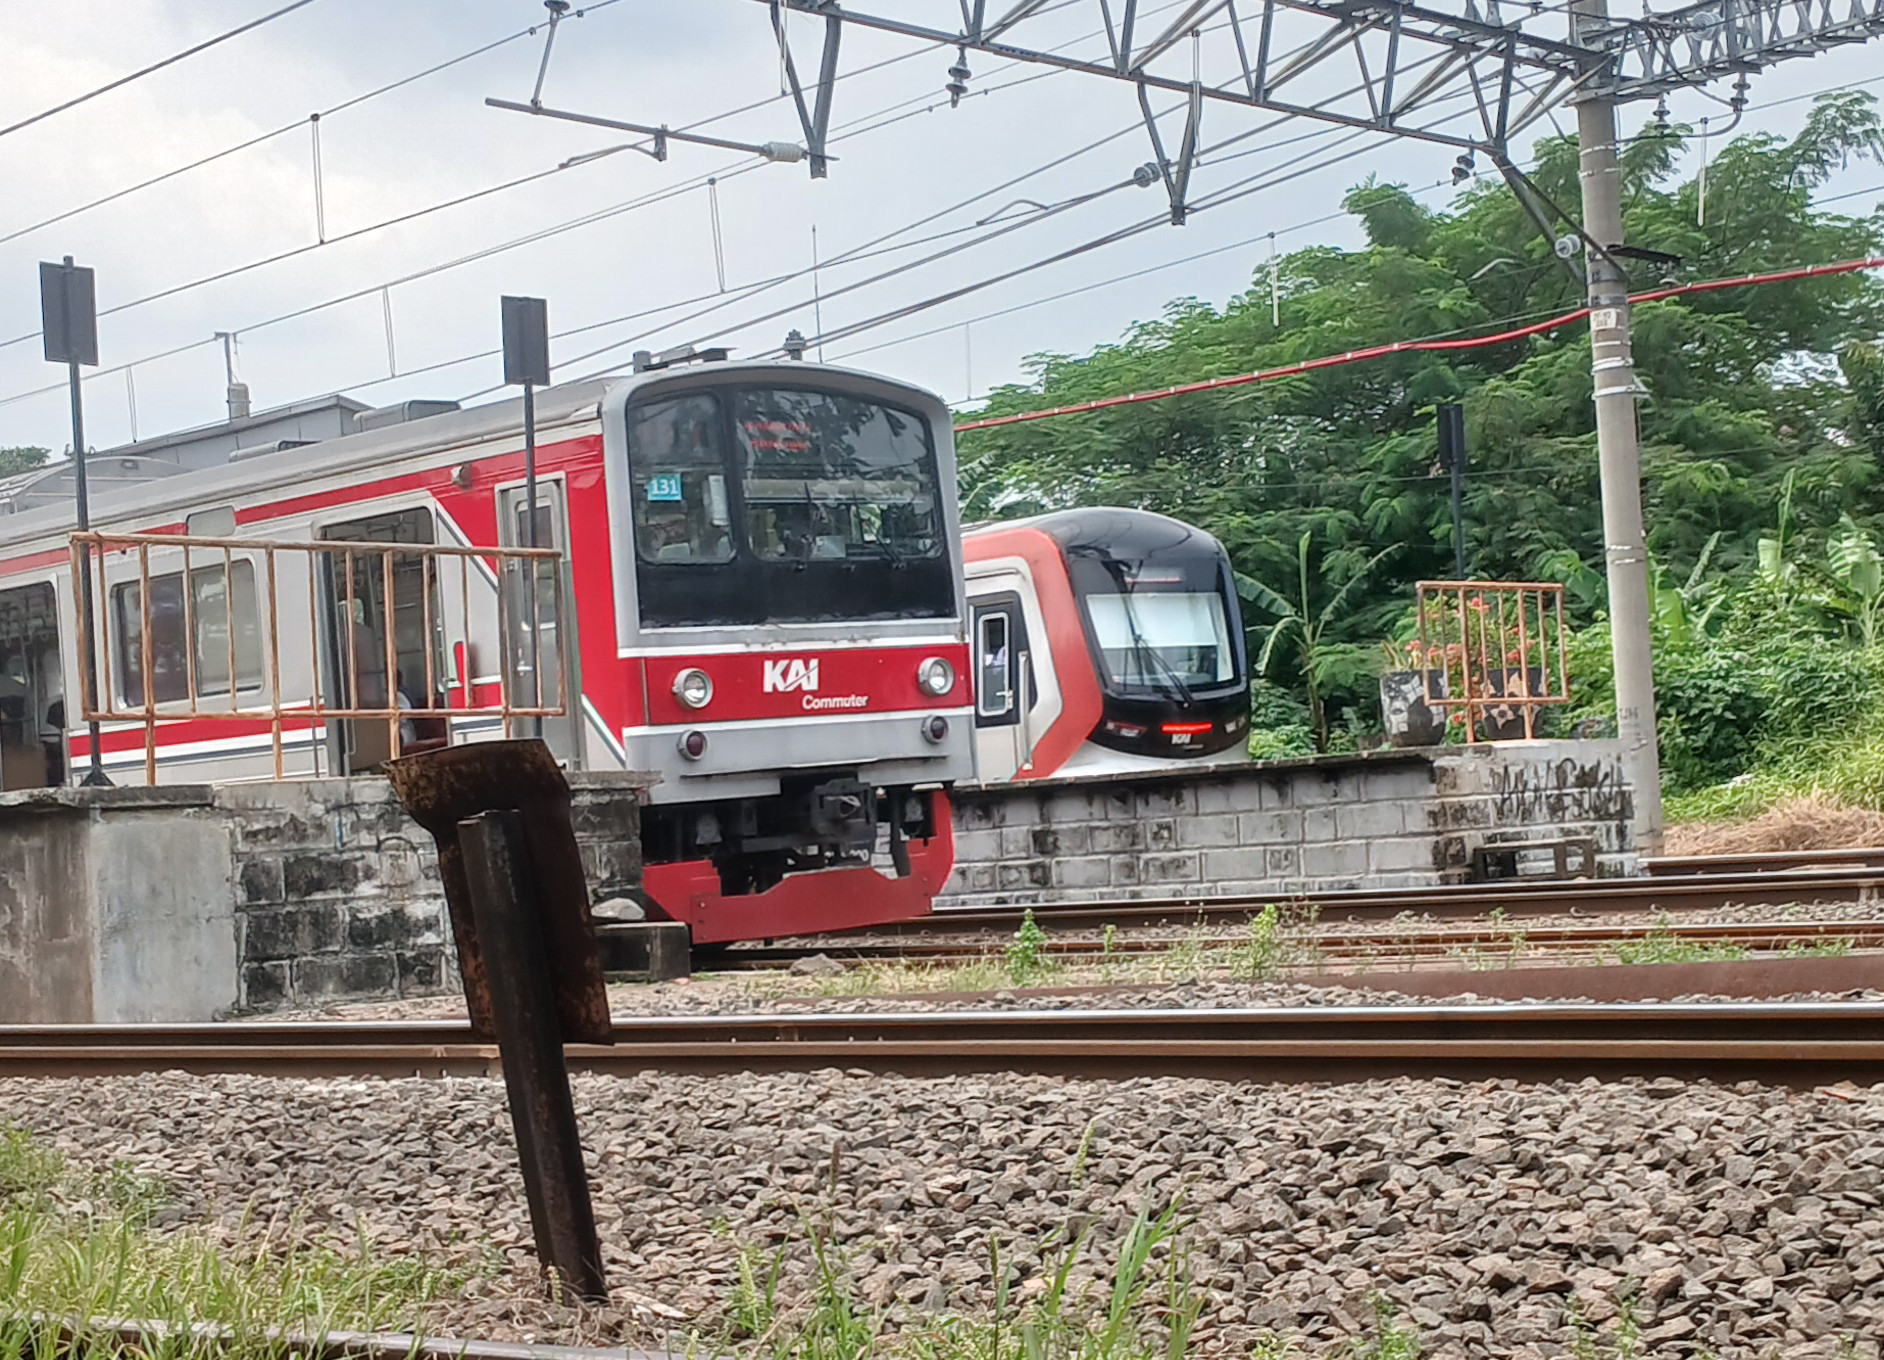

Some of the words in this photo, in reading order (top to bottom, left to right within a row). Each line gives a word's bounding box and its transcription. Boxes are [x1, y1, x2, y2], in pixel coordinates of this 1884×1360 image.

[650, 478, 678, 495] 131
[763, 658, 819, 693] KAI
[802, 694, 869, 710] Commuter
